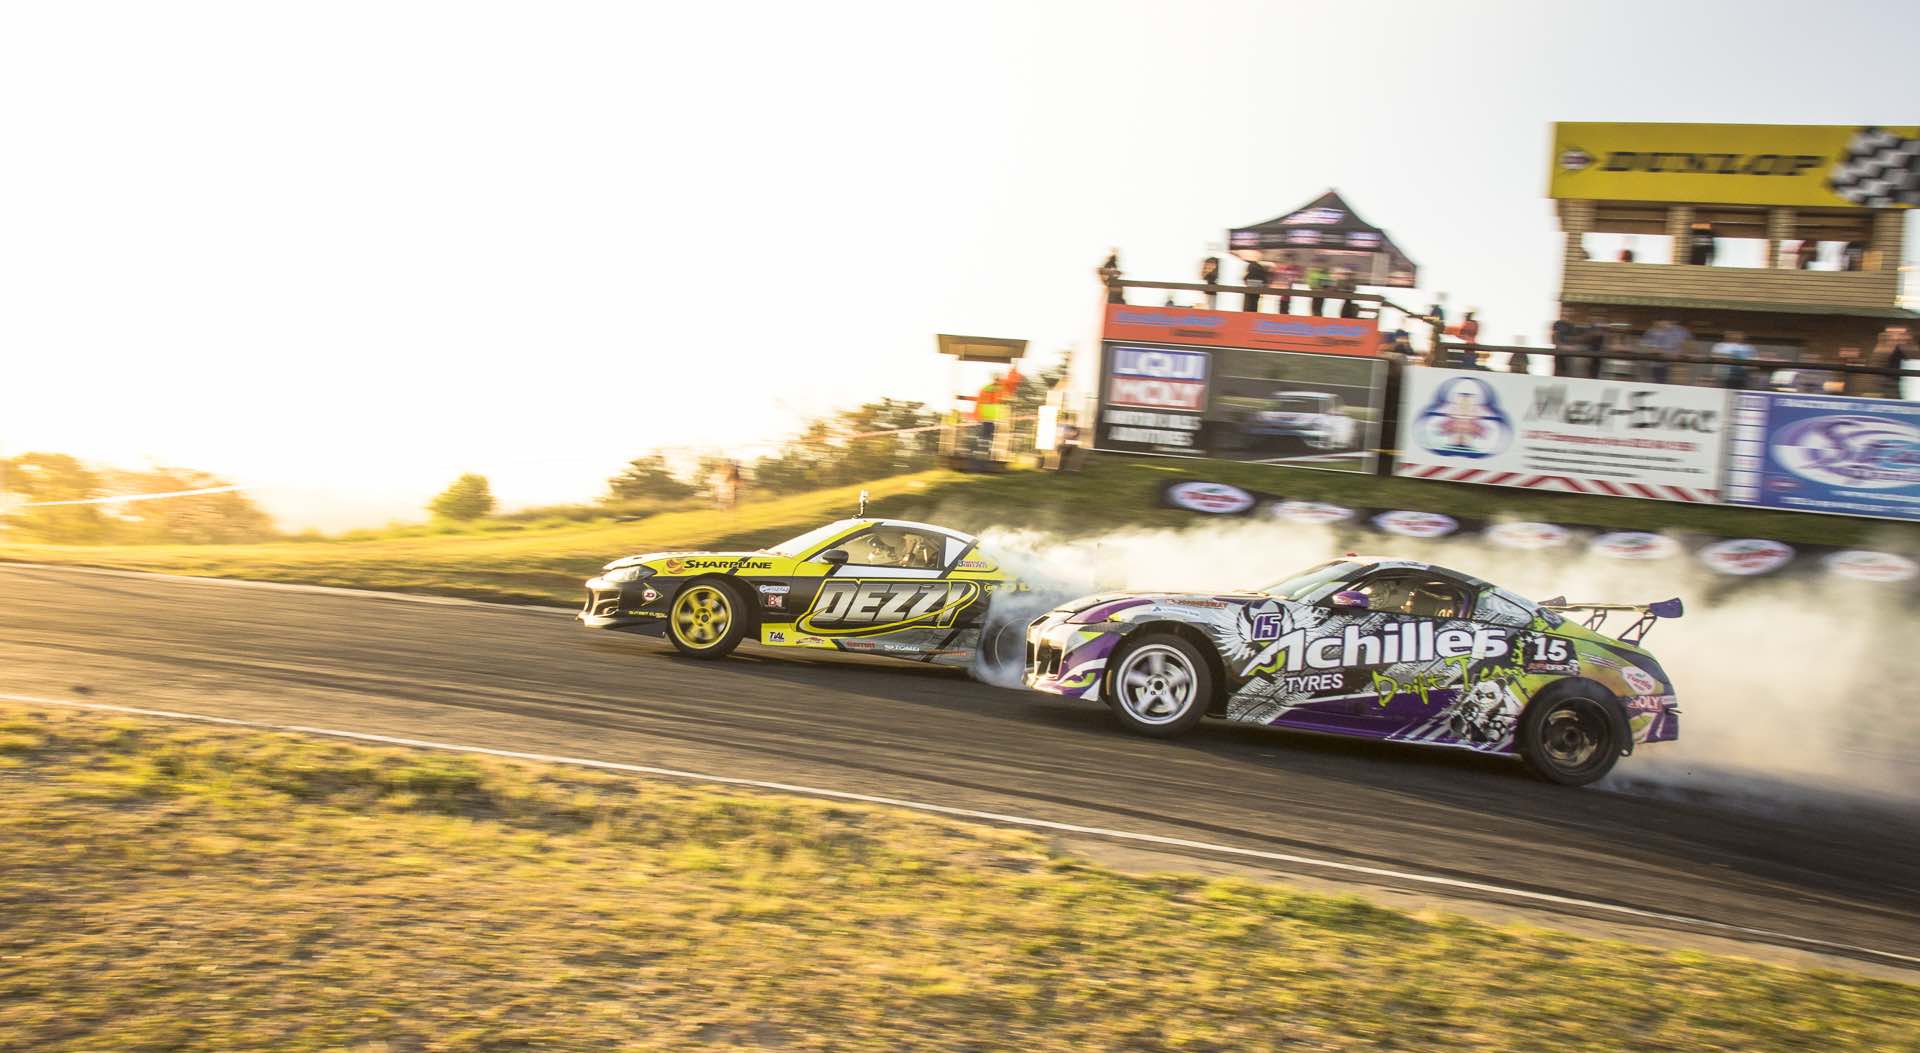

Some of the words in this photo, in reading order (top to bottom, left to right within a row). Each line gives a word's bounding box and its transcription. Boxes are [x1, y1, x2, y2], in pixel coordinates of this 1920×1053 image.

[1603, 151, 1823, 176] DUNLOP
[684, 560, 773, 569] SHARPLINE
[1239, 620, 1509, 678] Achilles
[1533, 639, 1569, 661] 15
[1286, 673, 1344, 693] TYRES
